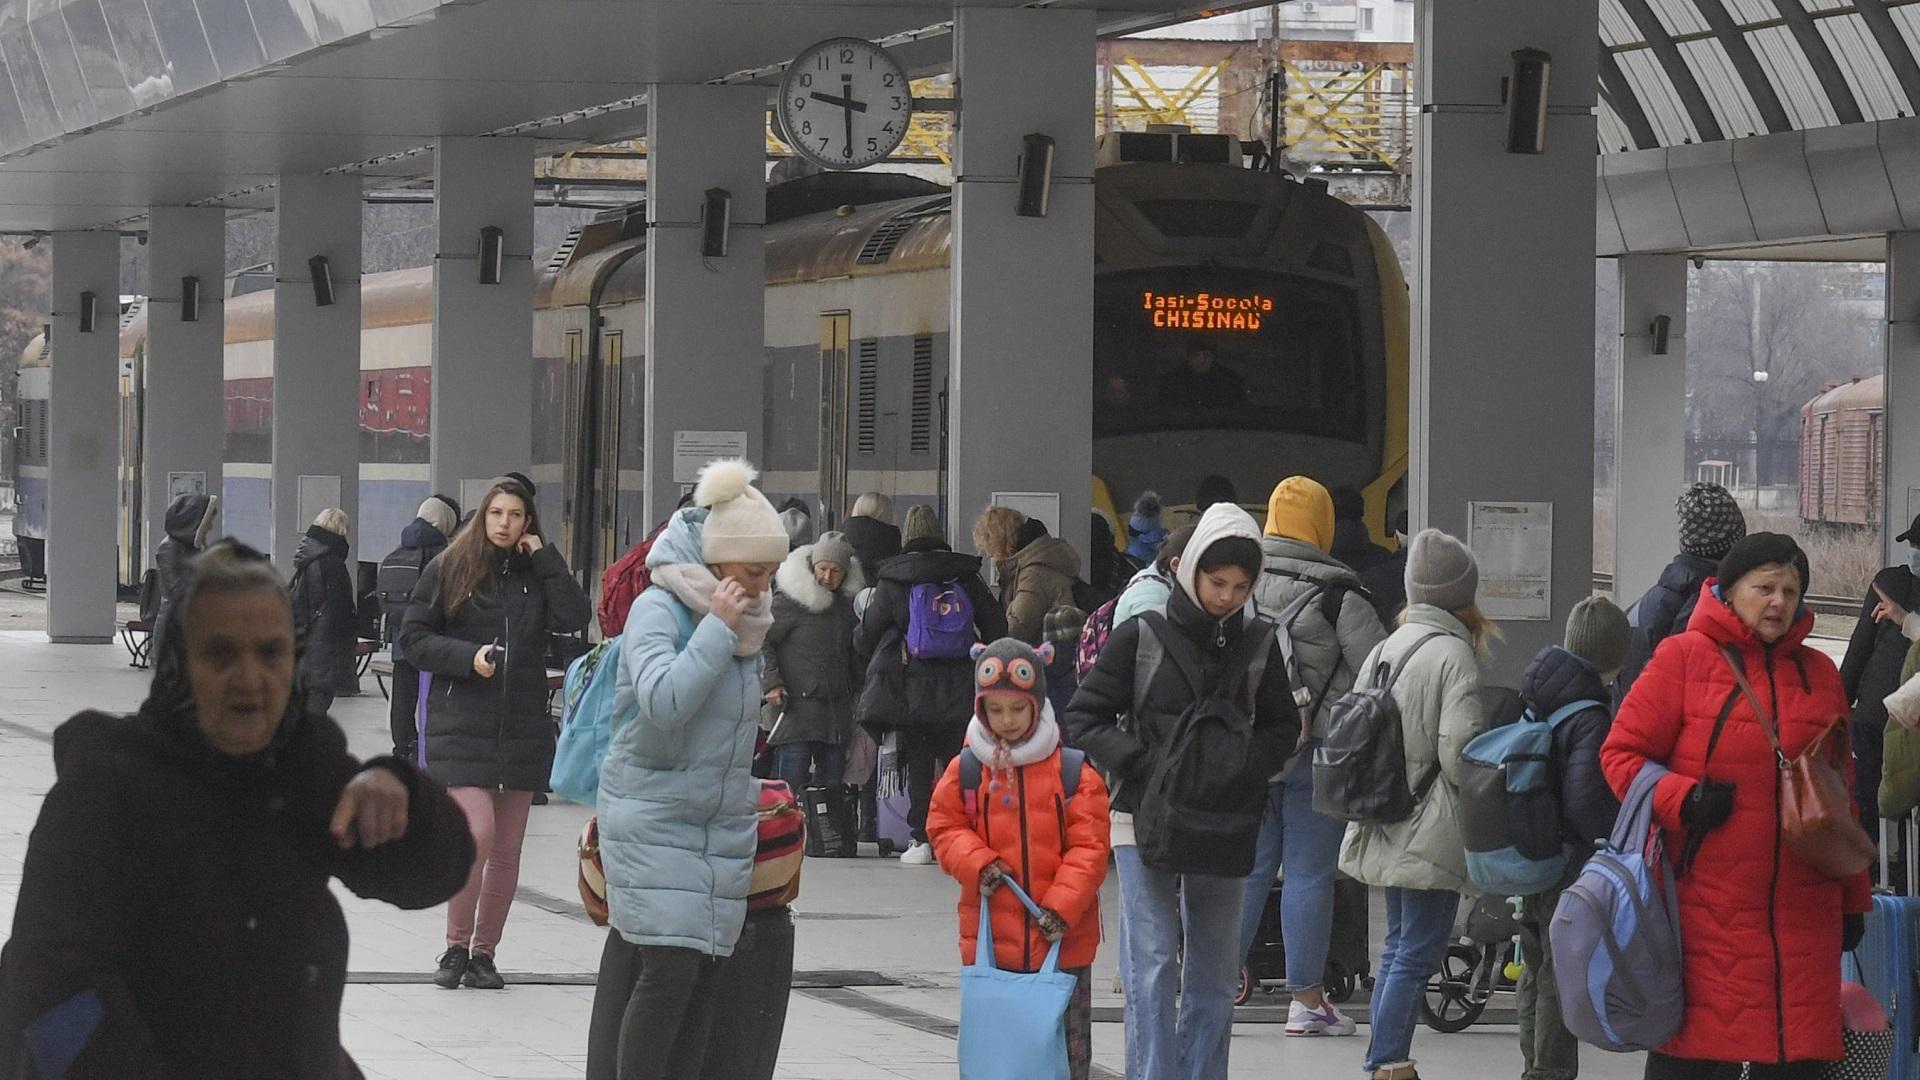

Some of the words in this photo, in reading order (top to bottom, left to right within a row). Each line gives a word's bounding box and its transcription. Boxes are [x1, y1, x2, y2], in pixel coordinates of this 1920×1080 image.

[818, 55, 829, 71] 11
[840, 49, 854, 64] 12
[799, 73, 813, 88] 10
[882, 73, 894, 88] 2
[794, 97, 806, 112] 9
[891, 96, 902, 111] 3
[801, 120, 812, 136] 8
[881, 121, 894, 135] 4
[818, 137, 829, 152] 7
[867, 137, 878, 152] 5
[1143, 291, 1274, 312] Iasi-Socola
[1153, 310, 1262, 330] CHISINAU
